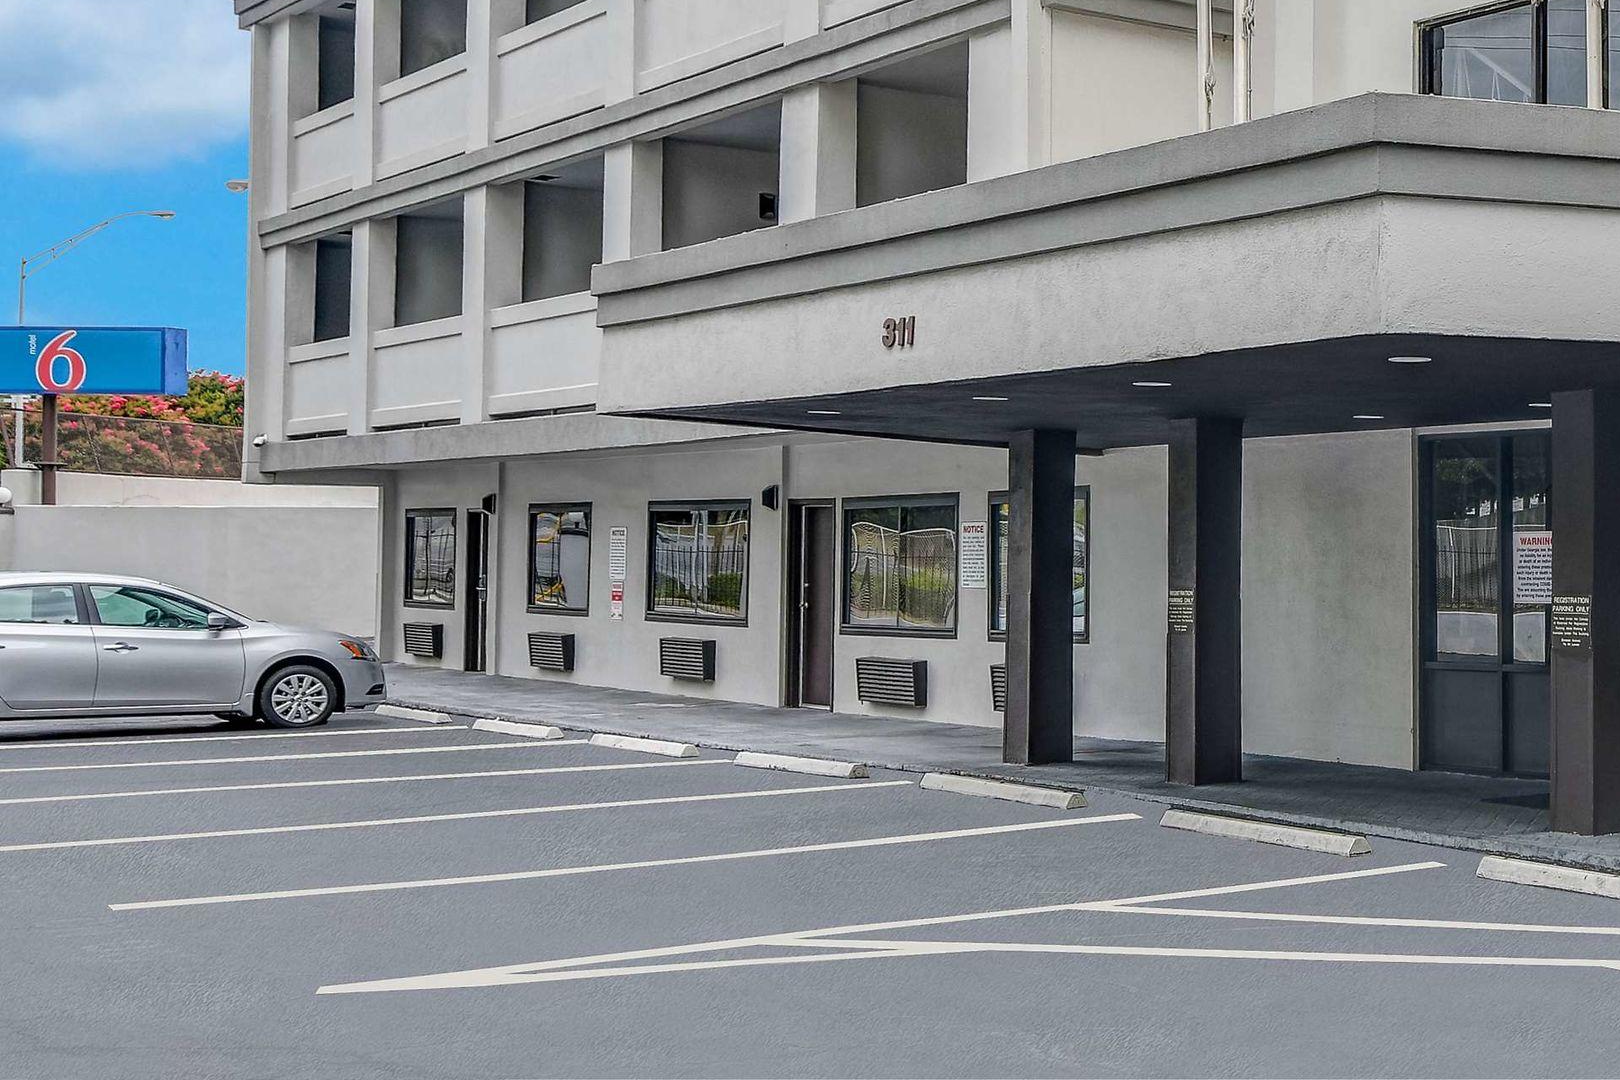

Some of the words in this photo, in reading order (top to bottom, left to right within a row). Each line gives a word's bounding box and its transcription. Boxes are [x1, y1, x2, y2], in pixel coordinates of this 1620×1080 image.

[28, 334, 37, 355] motel
[882, 315, 916, 348] 311
[35, 330, 87, 391] 6
[963, 525, 984, 533] NOTICE
